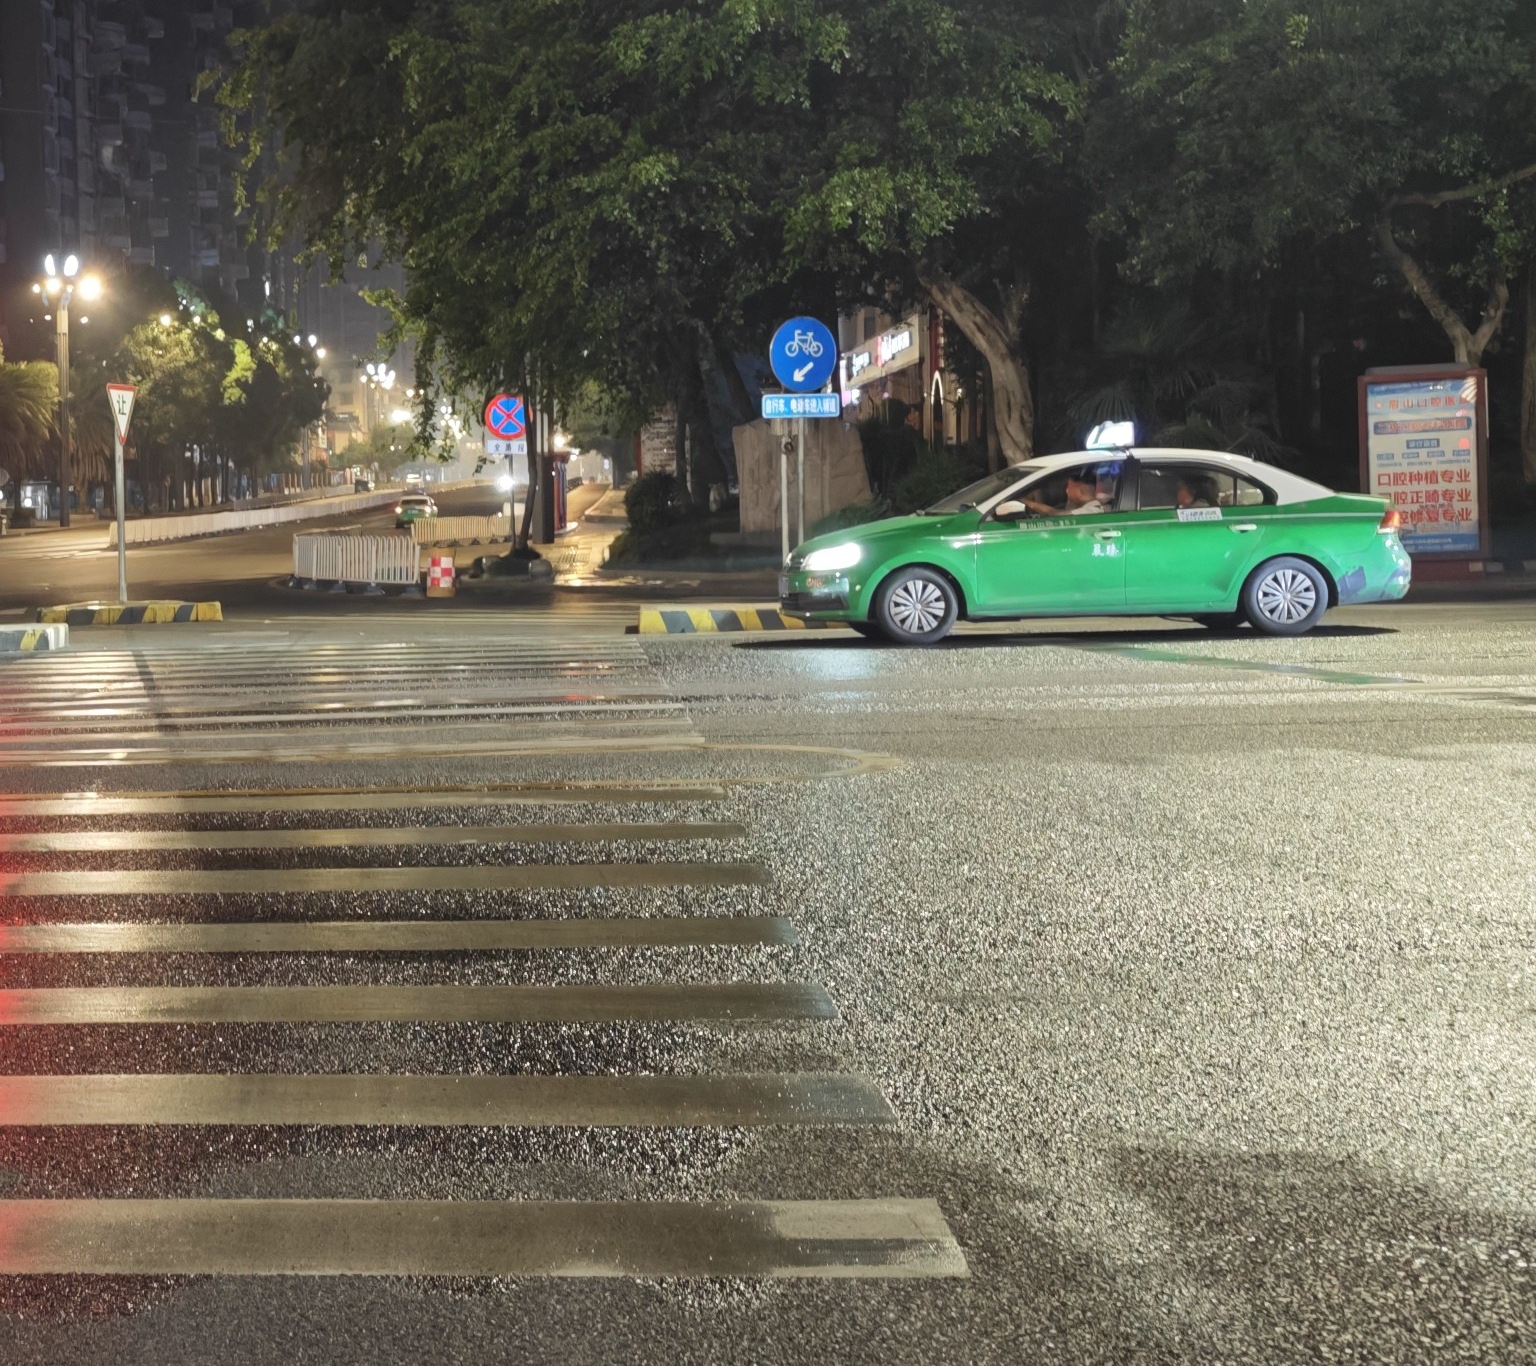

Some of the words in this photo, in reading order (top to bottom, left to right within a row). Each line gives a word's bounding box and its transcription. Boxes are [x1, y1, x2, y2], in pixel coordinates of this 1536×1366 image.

[116, 394, 126, 415] 让
[1388, 396, 1473, 409] 眉山口腔医
[1377, 468, 1471, 486] 口腔种植专业
[1377, 487, 1472, 506] 腔正畸专业
